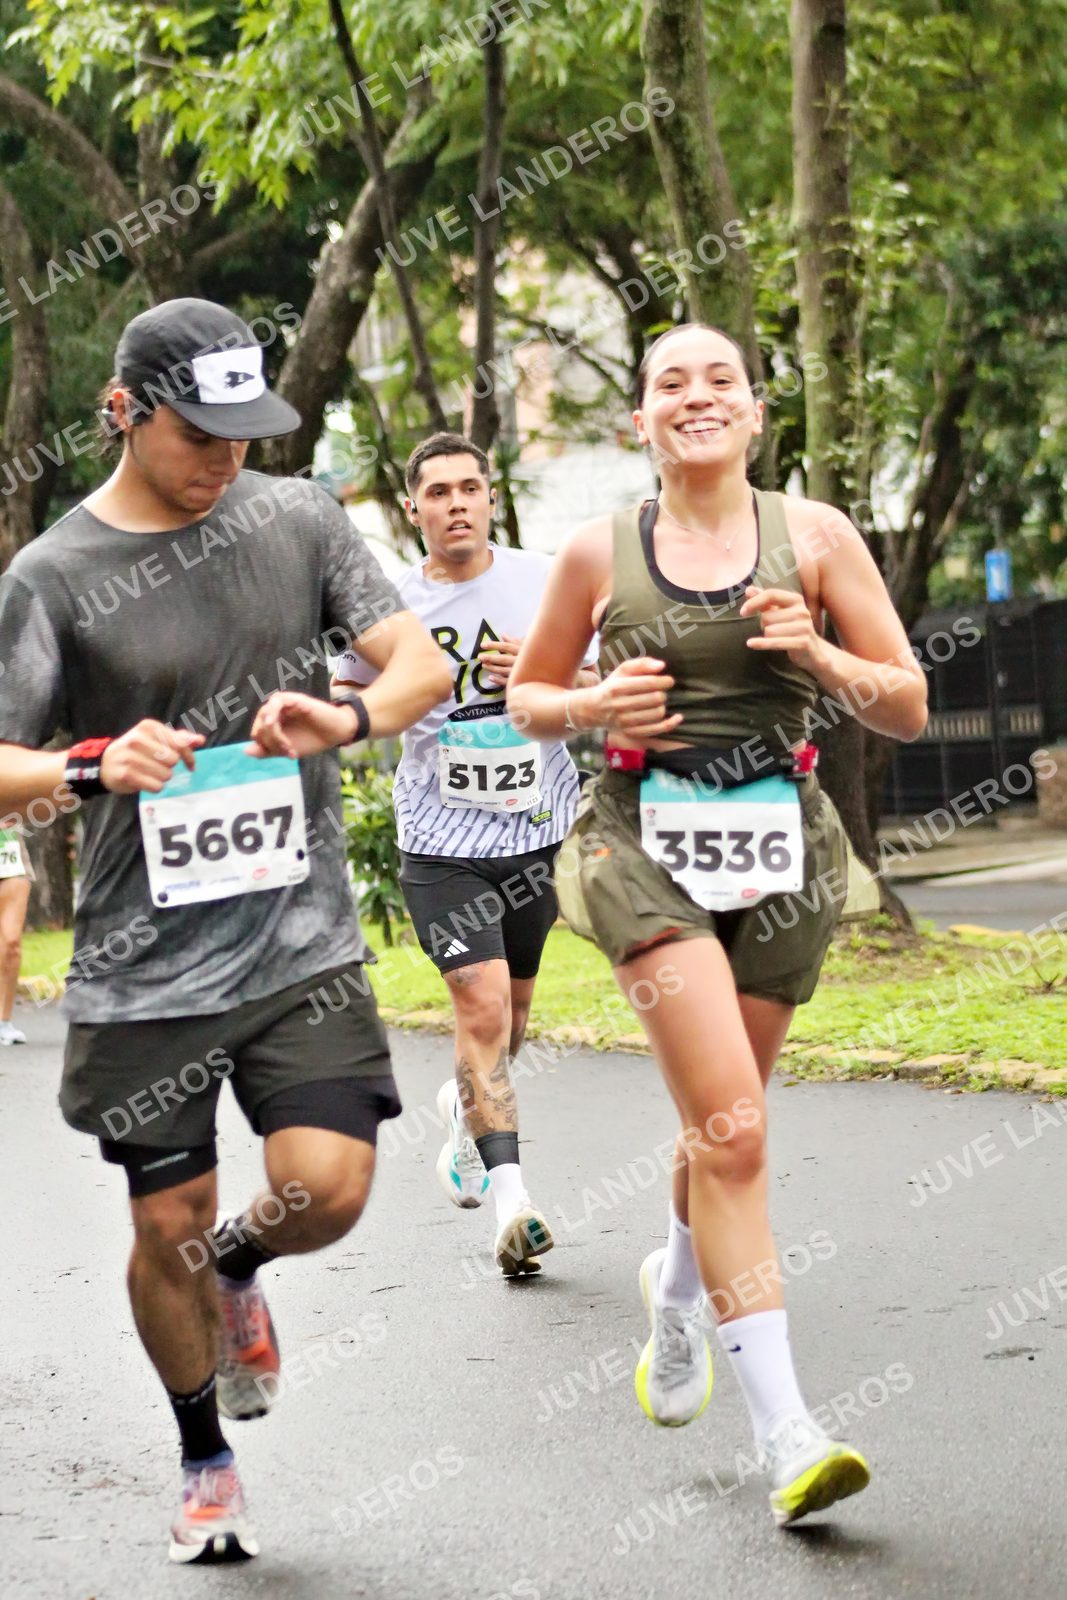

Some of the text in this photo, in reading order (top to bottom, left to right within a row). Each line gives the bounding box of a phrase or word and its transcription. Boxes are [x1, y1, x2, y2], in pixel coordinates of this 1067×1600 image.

[430, 618, 502, 662] RA
[447, 758, 536, 792] 5123
[158, 805, 293, 868] 5667
[655, 830, 792, 874] 3536
